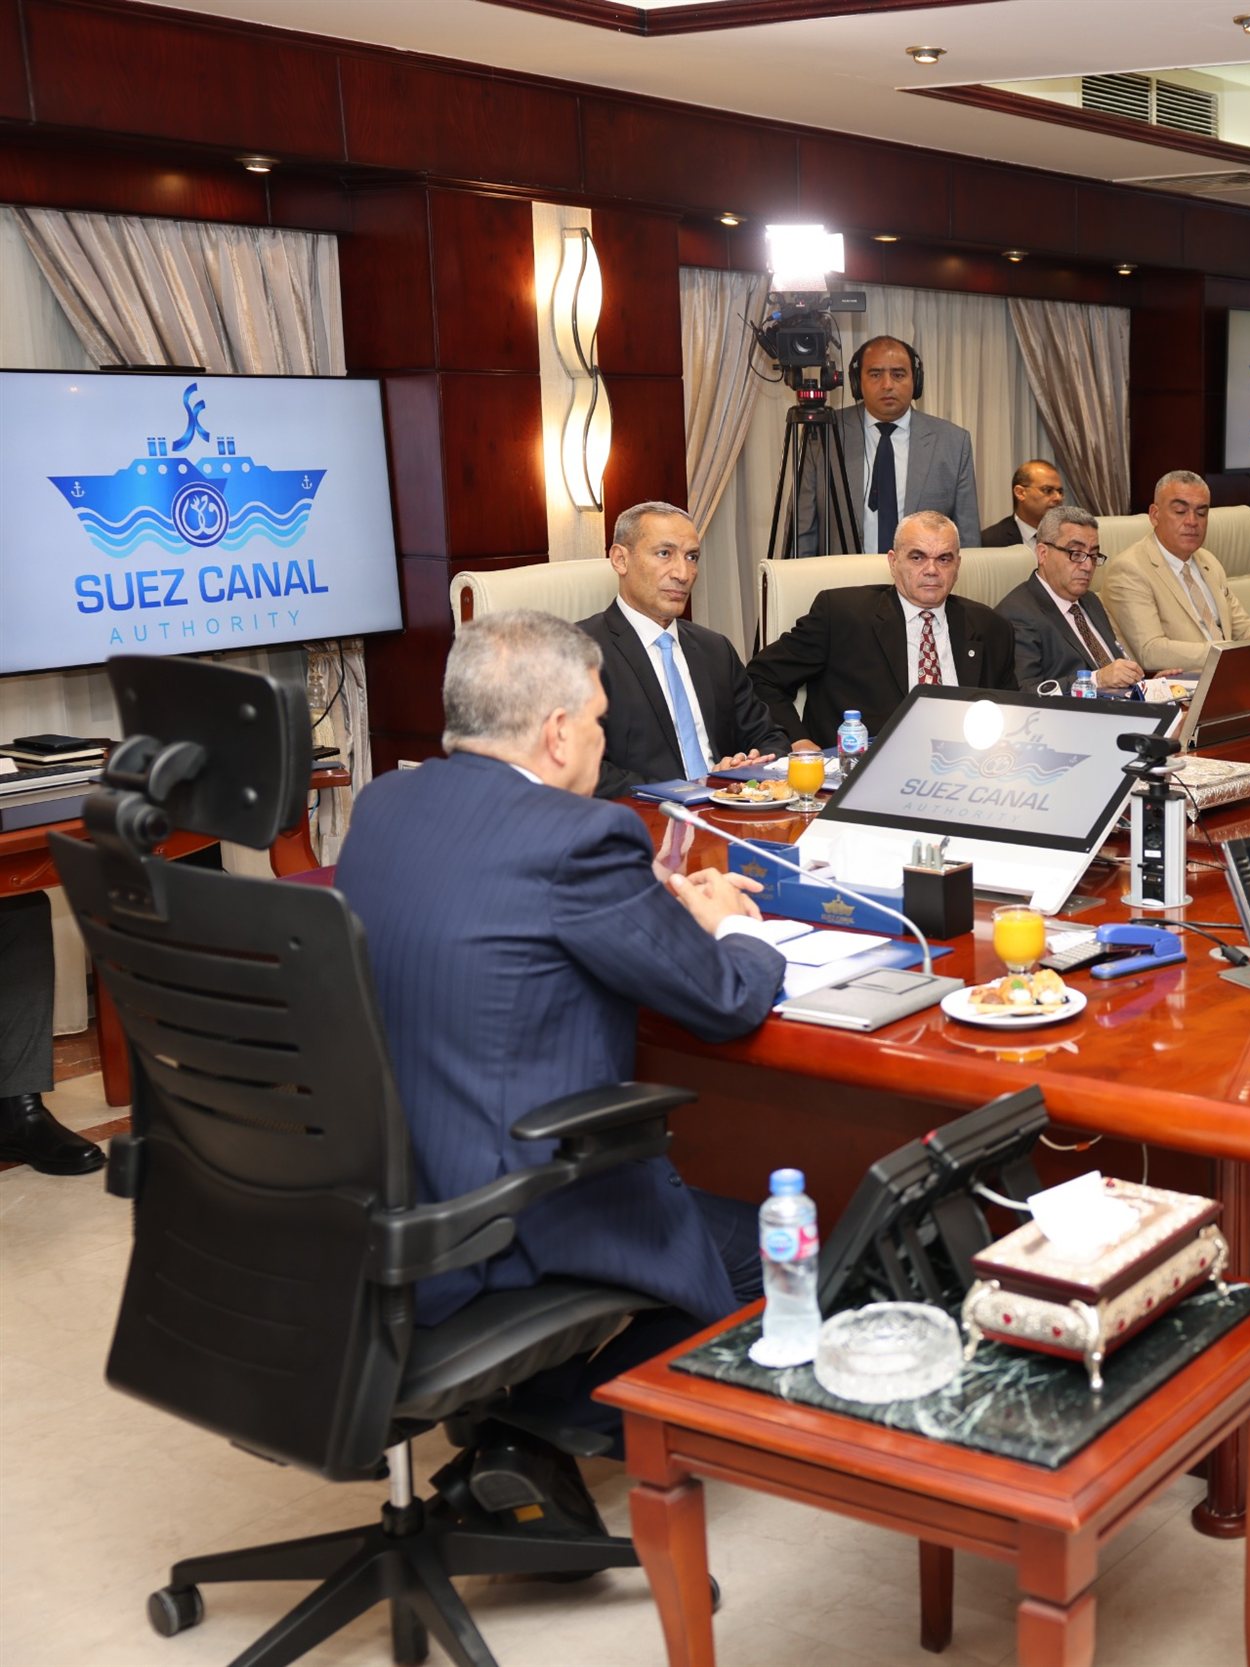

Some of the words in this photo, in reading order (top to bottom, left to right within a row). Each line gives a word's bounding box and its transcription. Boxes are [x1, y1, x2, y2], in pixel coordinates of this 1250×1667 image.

[74, 568, 189, 615] SUEZ
[197, 558, 330, 605] CANAL
[108, 609, 301, 646] AUTHORITY
[900, 777, 968, 802] SUEZ
[967, 785, 1051, 813] CANAL
[902, 801, 1022, 824] AUTHORITY
